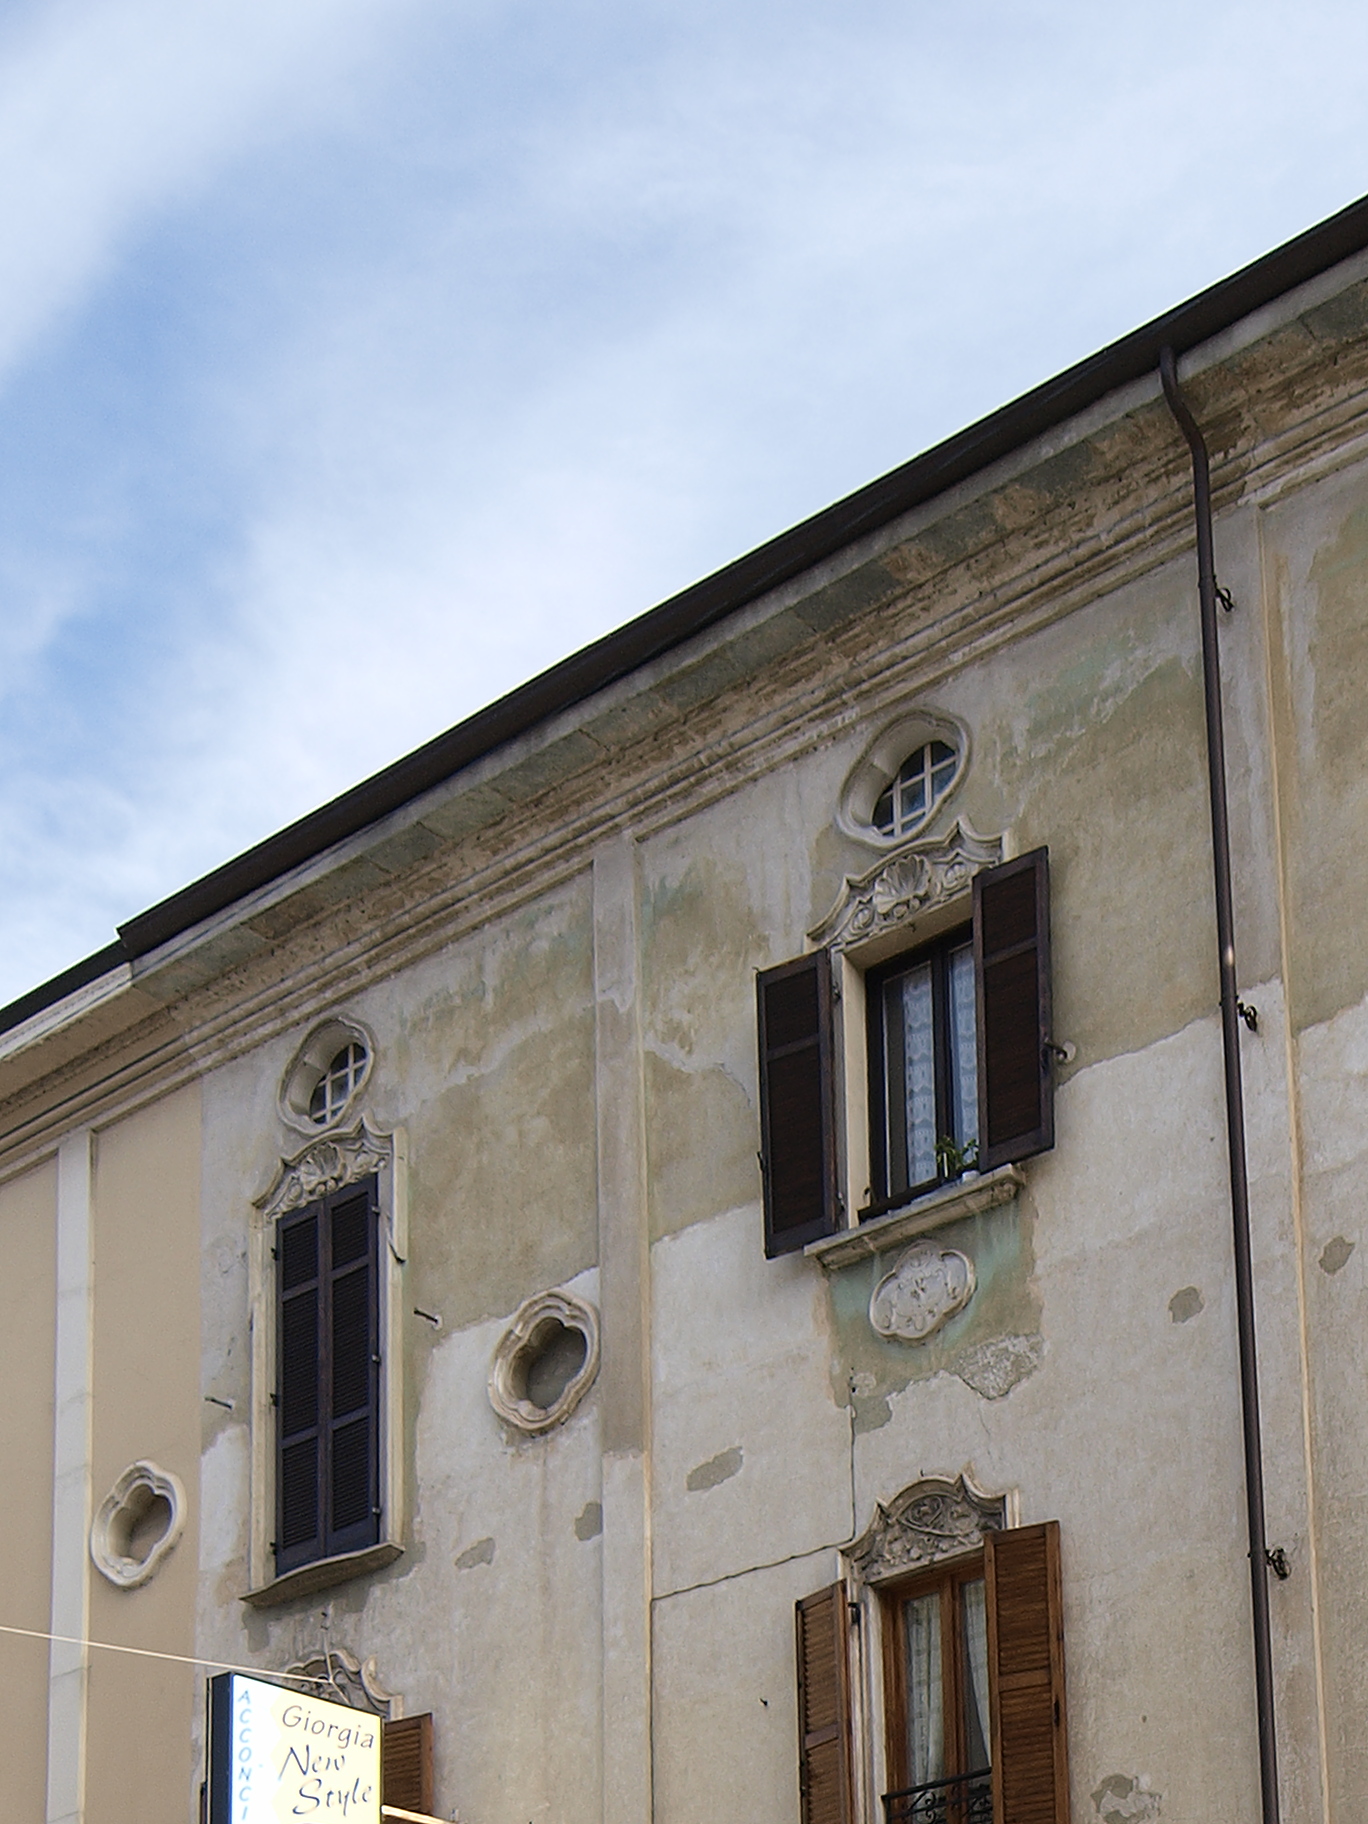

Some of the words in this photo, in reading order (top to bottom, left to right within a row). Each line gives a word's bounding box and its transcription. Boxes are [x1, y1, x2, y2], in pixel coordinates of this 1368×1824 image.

[282, 1704, 374, 1750] Giorgia
[278, 1744, 346, 1781] New
[292, 1777, 372, 1816] Style
